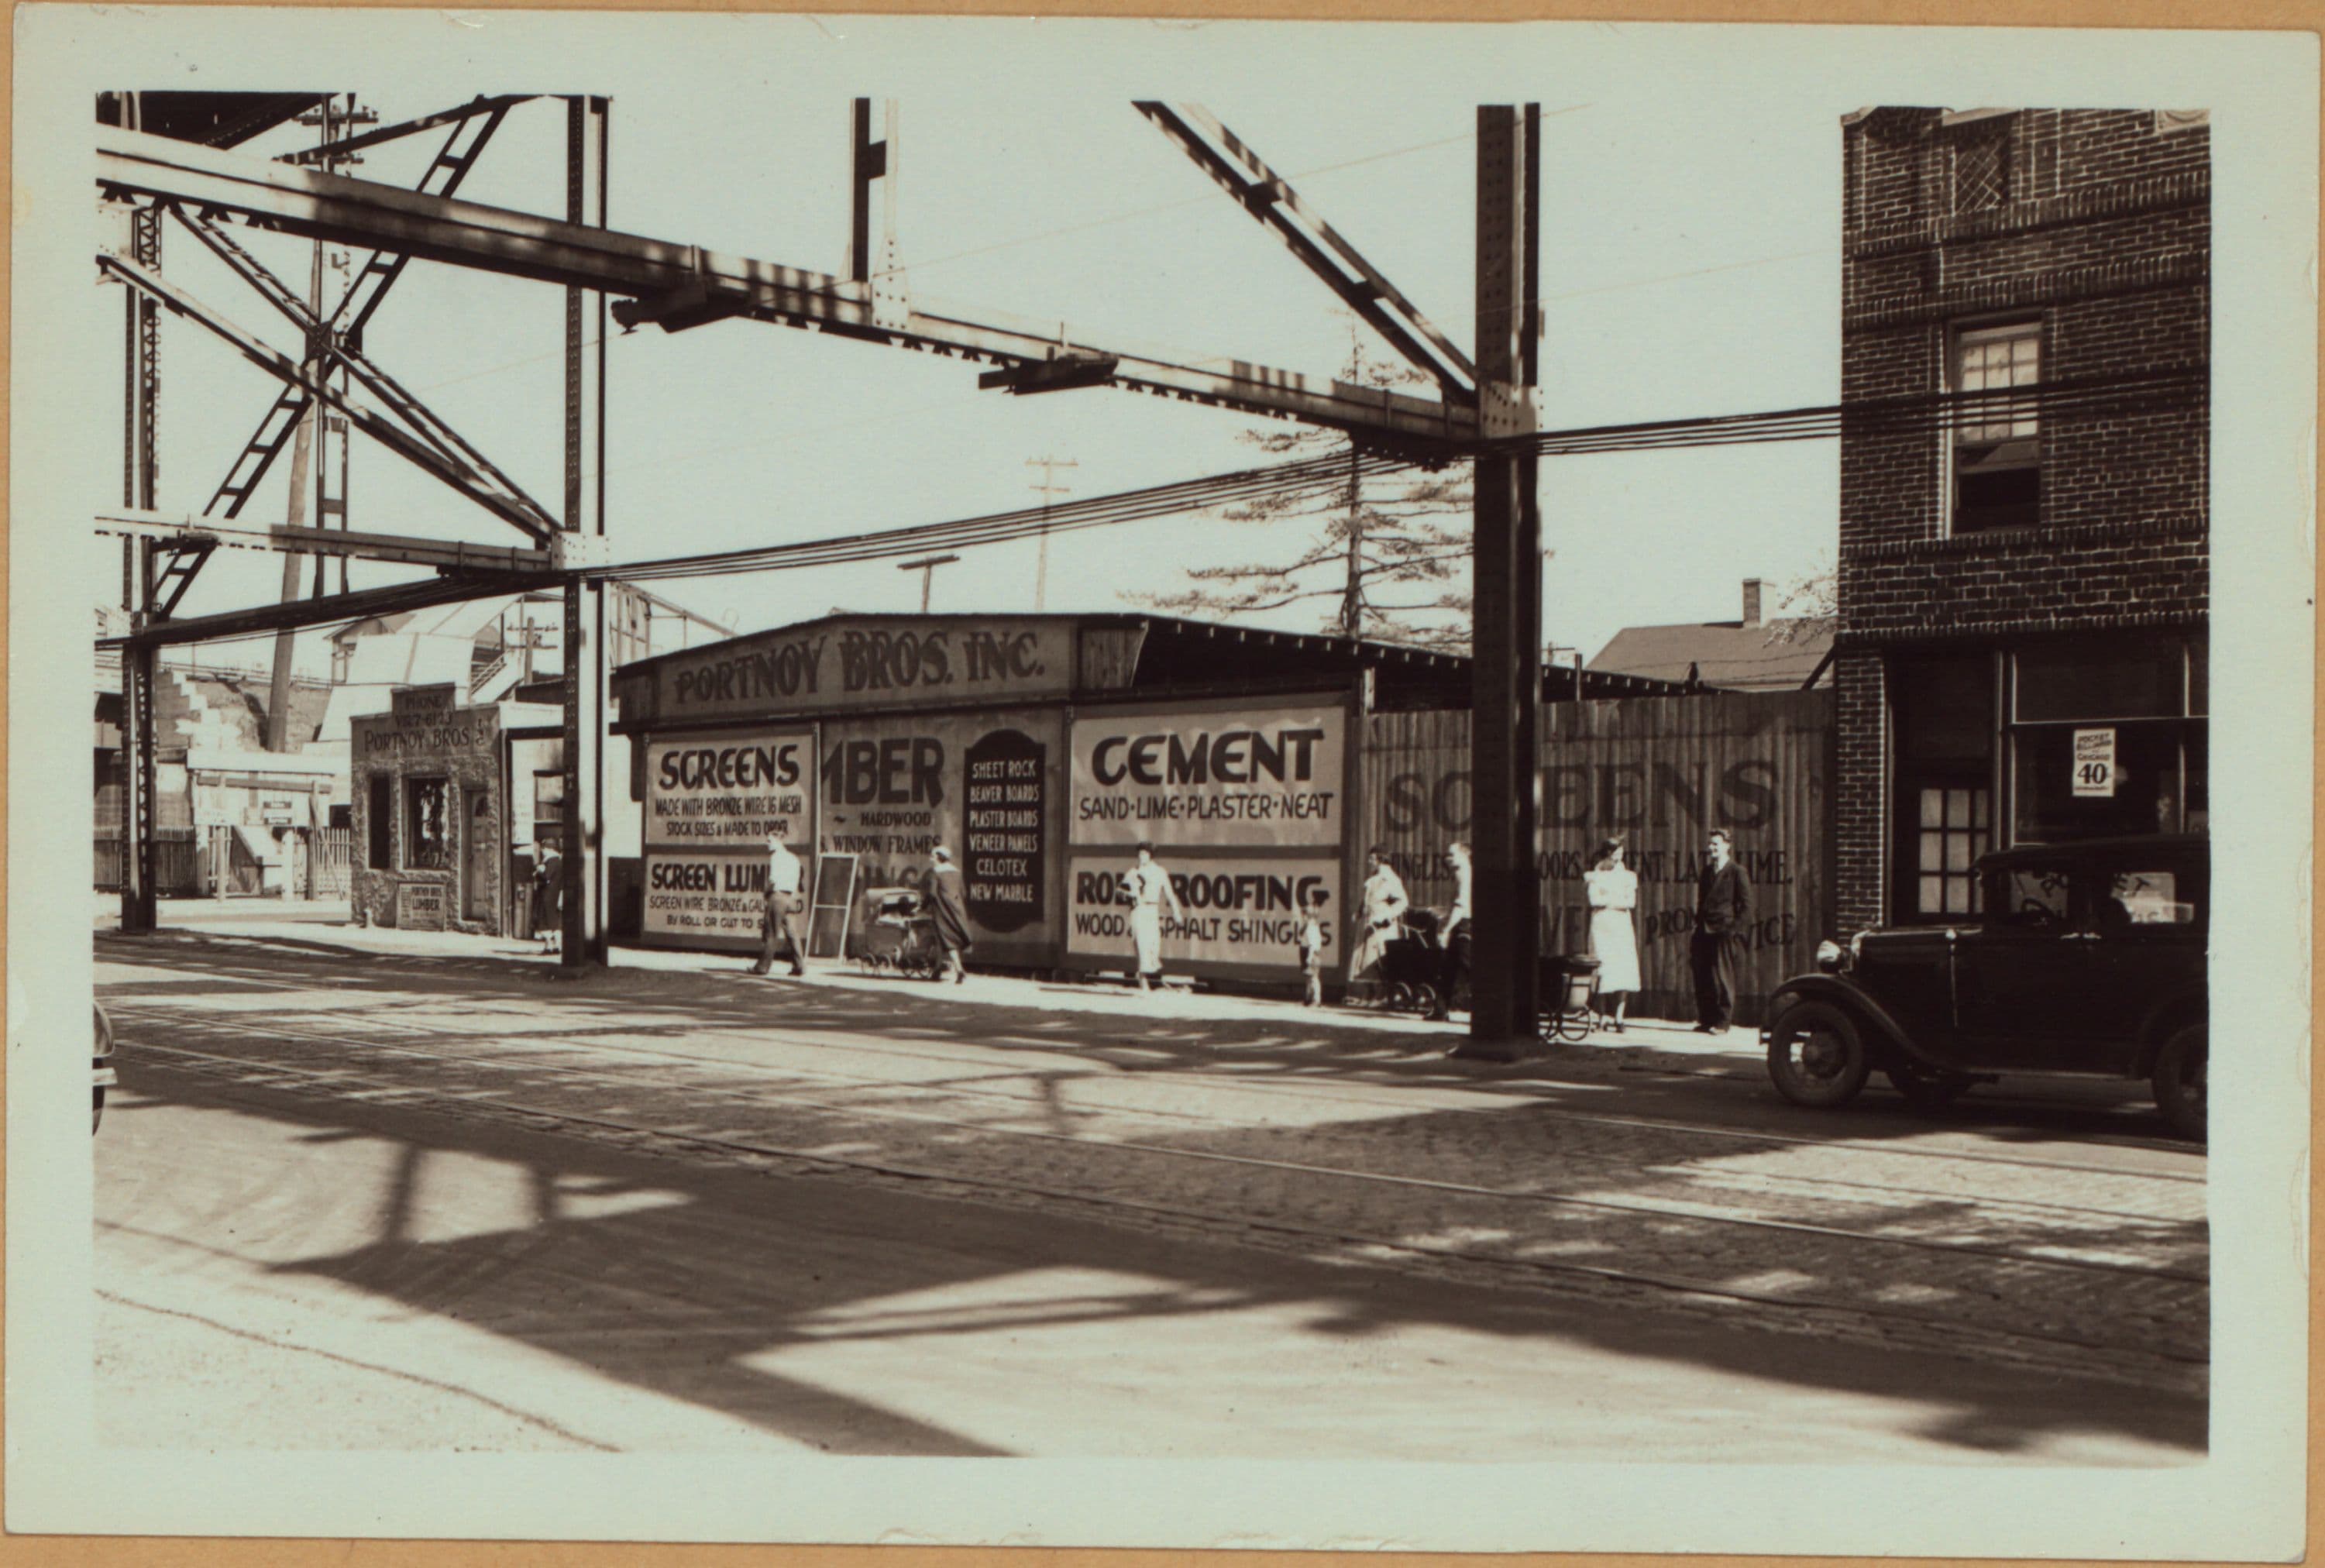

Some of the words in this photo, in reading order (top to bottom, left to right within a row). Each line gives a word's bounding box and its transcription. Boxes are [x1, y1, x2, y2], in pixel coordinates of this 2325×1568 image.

[674, 635, 827, 703] PORTNOY
[837, 630, 953, 692] BROS.
[963, 631, 1045, 682] INC.
[364, 729, 425, 752] PORTNOY
[433, 727, 470, 748] BROS
[659, 744, 800, 790] SCREENS
[1092, 728, 1325, 786] CEMENT
[972, 761, 1005, 779] SHEET
[1008, 759, 1037, 778] ROCK
[2077, 762, 2107, 785] 40
[970, 785, 1003, 803] BEAVER
[1006, 783, 1040, 803] BOARDS
[1386, 760, 1779, 834] SCEENS
[655, 797, 680, 817] MADE
[682, 797, 703, 816] WITH
[706, 796, 742, 816] BRONZE
[745, 796, 767, 815] WIRE
[779, 795, 802, 813] MESH
[666, 820, 693, 837] STOCK
[694, 821, 716, 837] SIZES
[724, 820, 749, 837] MADE
[751, 820, 762, 836] TO
[861, 811, 932, 827] HARDWOOD
[969, 810, 1006, 828] PLASTER
[1007, 810, 1038, 828] BOARDS
[833, 835, 882, 852] WINDOW
[888, 835, 941, 855] FRAMES
[969, 834, 1006, 852] VENEER
[1007, 834, 1038, 853] PANELS
[652, 862, 717, 892] SCREEN
[976, 858, 1027, 877] CELOTEX
[970, 883, 993, 901] NEW
[995, 884, 1034, 903] MARBLE
[1165, 874, 1330, 912] ROOFING
[412, 899, 441, 912] LUMBER
[649, 896, 682, 910] SCREEN
[684, 897, 704, 911] WIRE
[708, 897, 741, 913] BRONZE
[679, 915, 701, 927] ROLL
[703, 916, 717, 927] OR
[721, 917, 738, 929] CUT
[741, 918, 753, 929] TO
[1075, 913, 1125, 937] WOOD
[1227, 920, 1333, 947] SHINGLS
